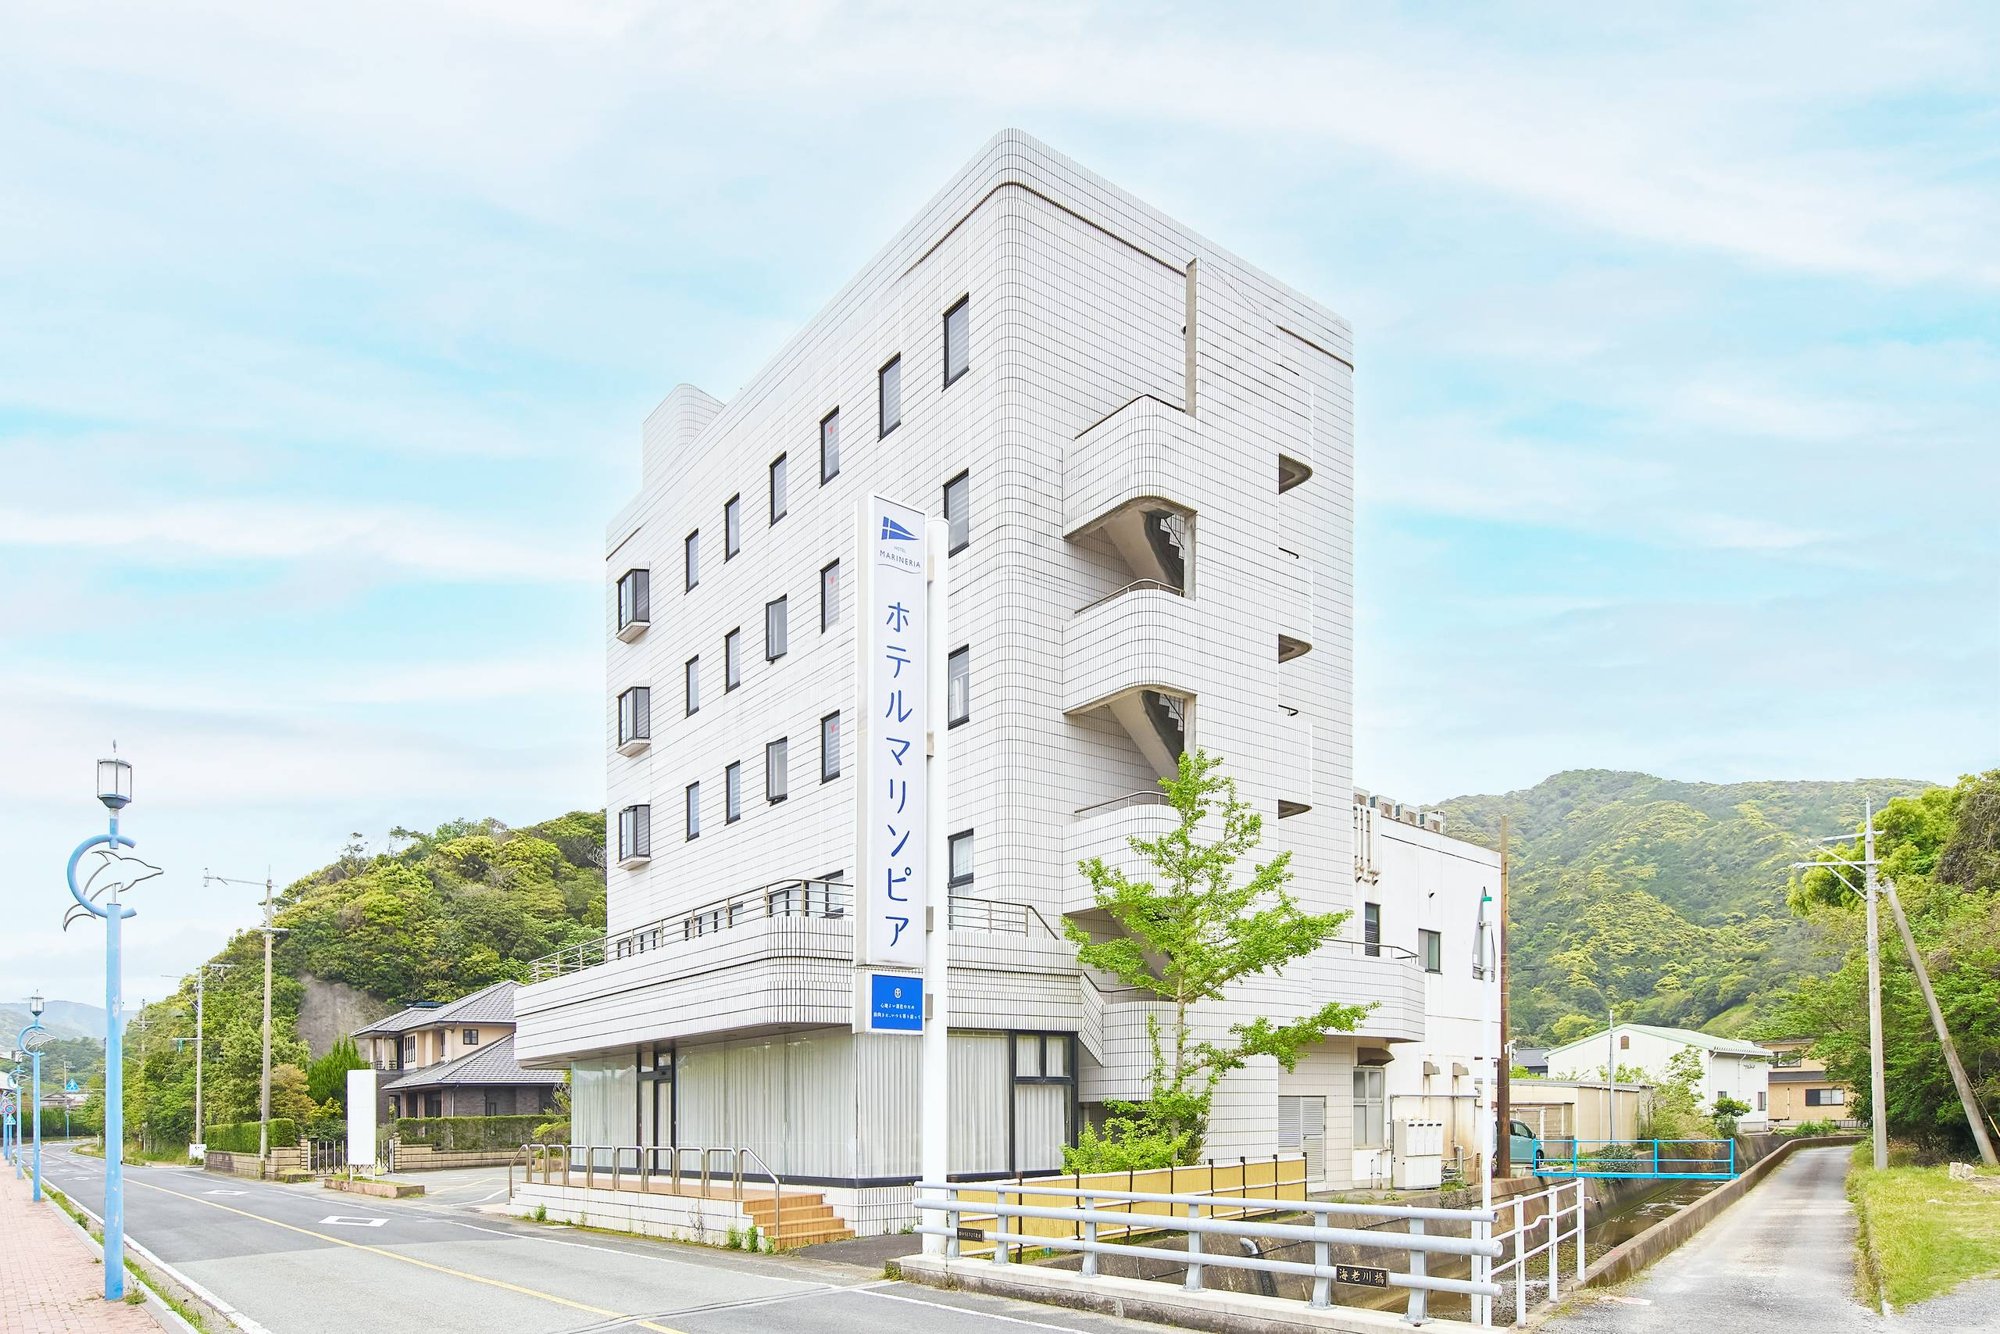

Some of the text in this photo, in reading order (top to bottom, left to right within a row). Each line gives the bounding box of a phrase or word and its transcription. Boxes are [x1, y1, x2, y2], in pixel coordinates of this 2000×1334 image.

[879, 549, 921, 569] MARINERIA
[886, 602, 913, 947] ホテルマリンピア
[1339, 1268, 1384, 1285] 海老川橋
